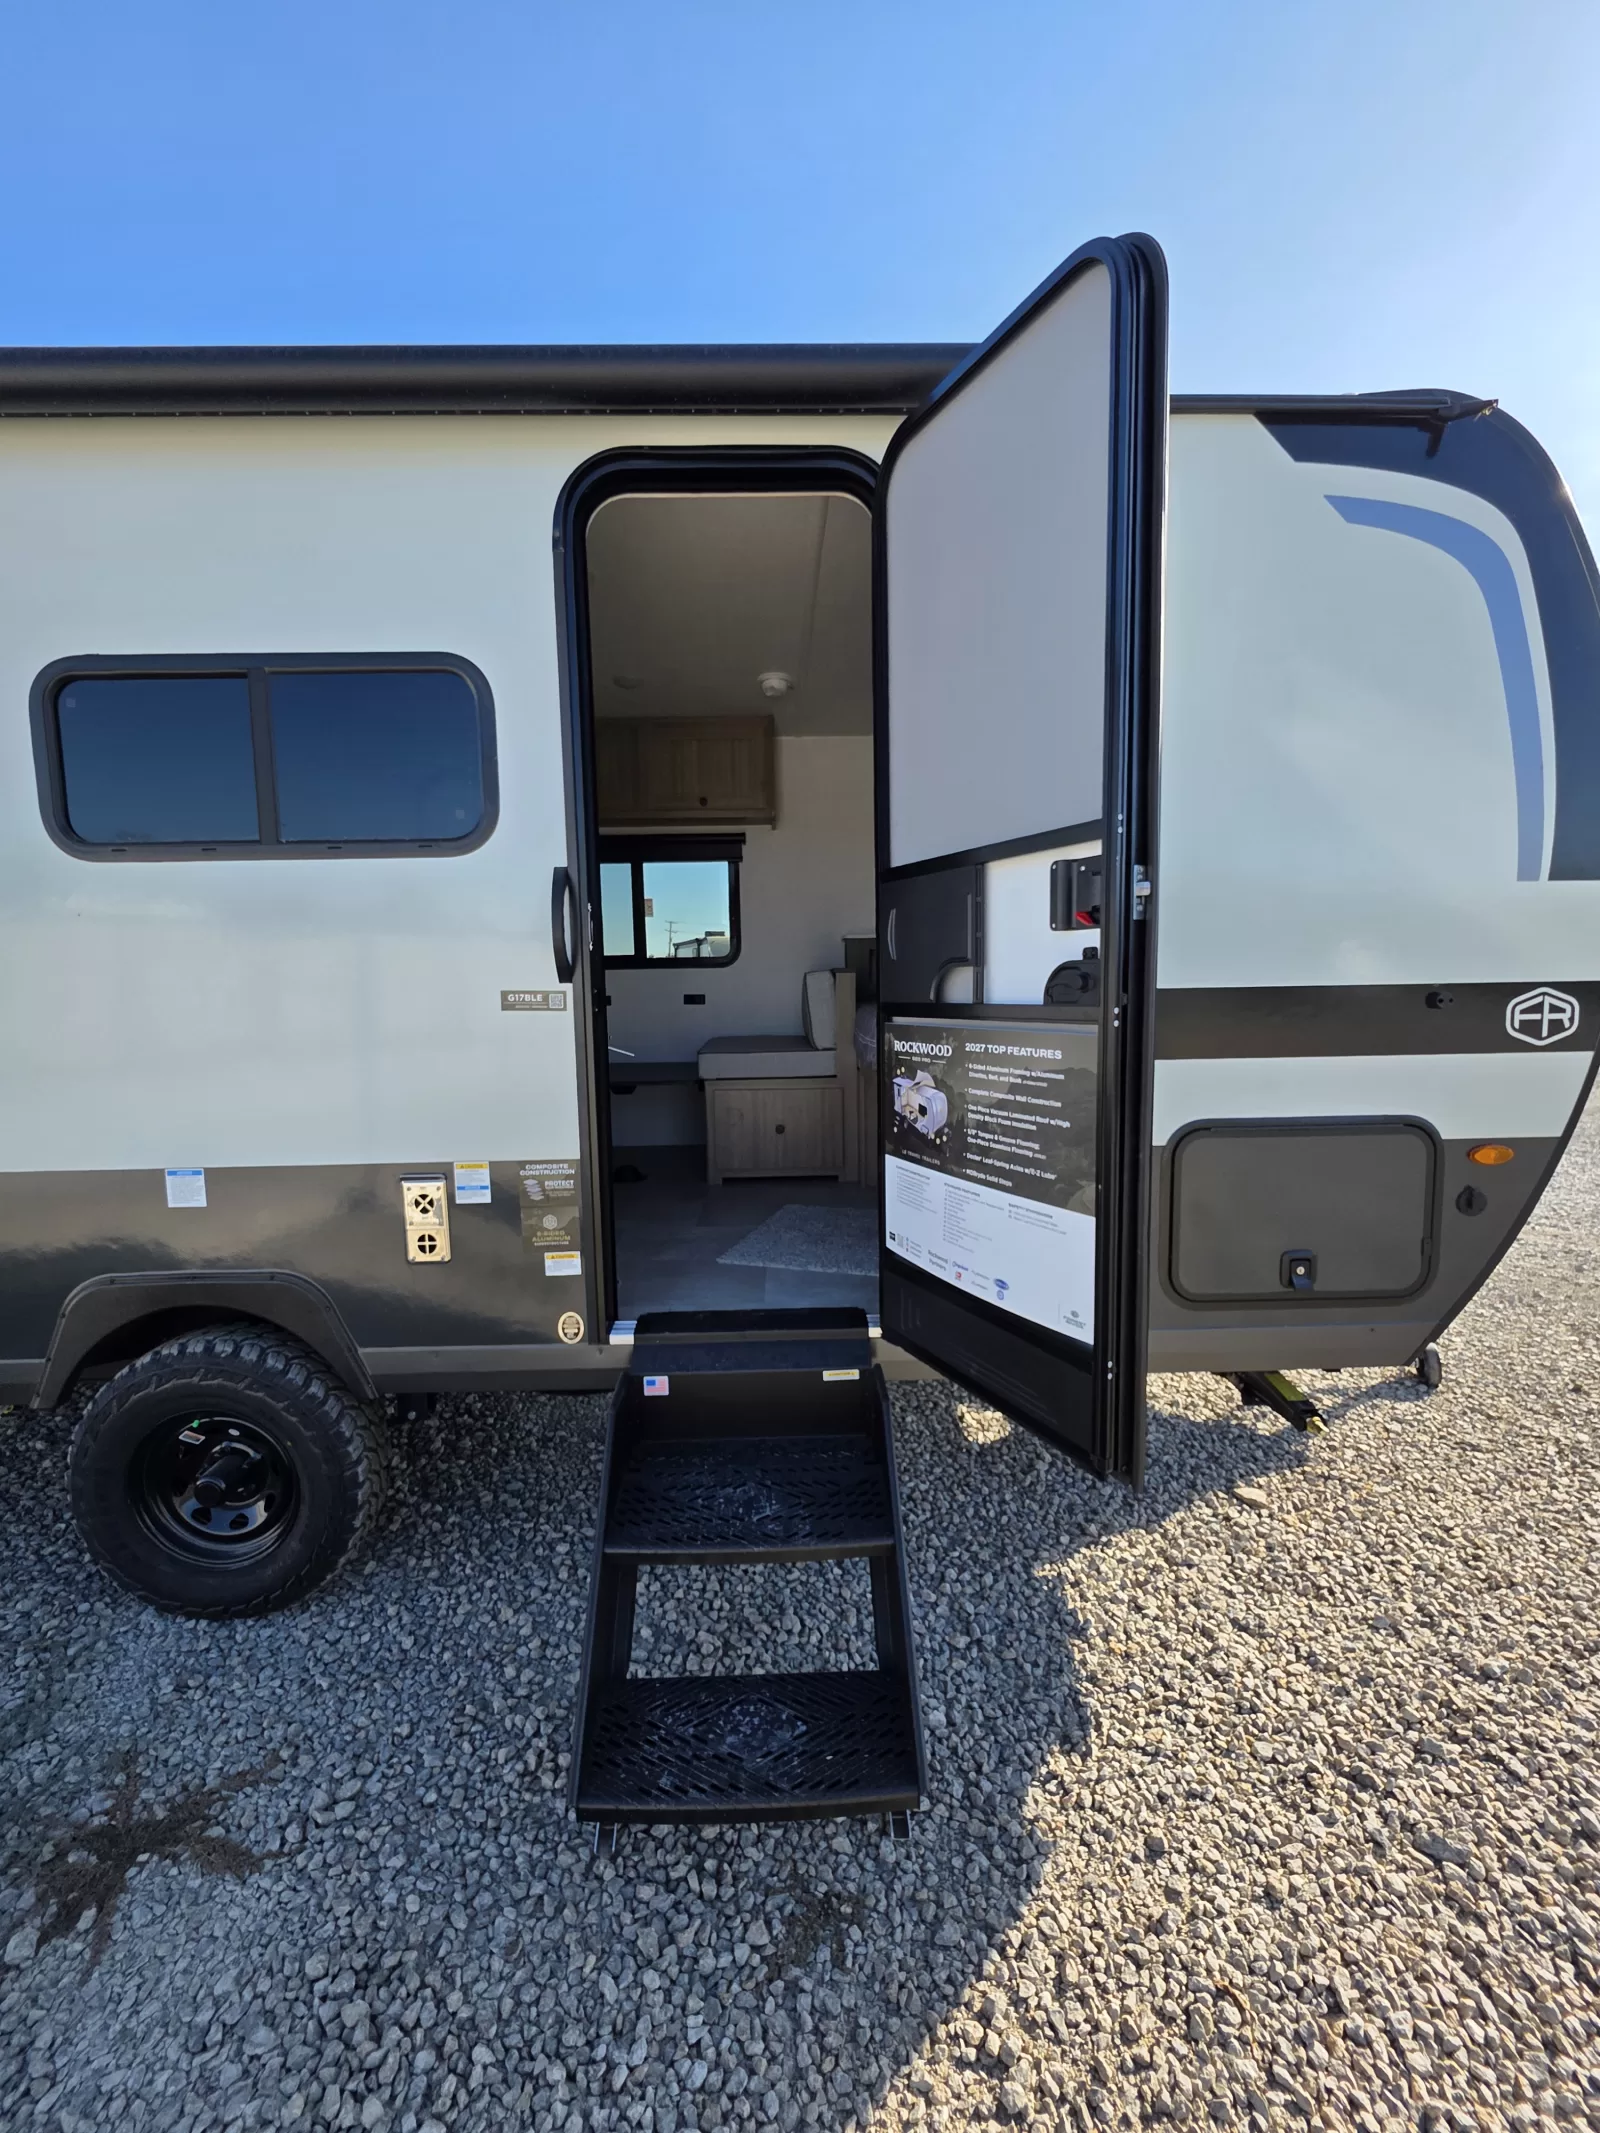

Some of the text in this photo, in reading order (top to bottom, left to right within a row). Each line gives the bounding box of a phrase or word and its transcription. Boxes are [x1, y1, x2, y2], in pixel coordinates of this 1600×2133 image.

[507, 994, 543, 1002] G17BLE
[894, 1040, 952, 1057] ROCKWOOD
[965, 1043, 1062, 1059] 2027 TOP FEATURES
[987, 1065, 1009, 1073] Aluminum
[1010, 1068, 1031, 1077] Framing
[969, 1088, 989, 1096] Complete
[990, 1091, 1015, 1100] Composite
[1028, 1096, 1062, 1107] Construction
[968, 1112, 984, 1121] Density
[998, 1118, 1011, 1126] Foam
[1012, 1121, 1037, 1130] Insulation
[978, 1105, 989, 1113] Piece
[990, 1108, 1008, 1116] Vacuum
[1009, 1111, 1035, 1121] Laminated
[1036, 1116, 1049, 1124] Roof
[978, 1130, 993, 1139] Tongue
[967, 1136, 989, 1147] One-Piece
[1012, 1146, 1033, 1158] Flooring
[922, 1155, 940, 1166] TRAILERS
[983, 1156, 1009, 1170] Leaf-Spring
[1010, 1164, 1024, 1172] Axles
[987, 1174, 998, 1183] Solid
[999, 1178, 1012, 1187] Steps
